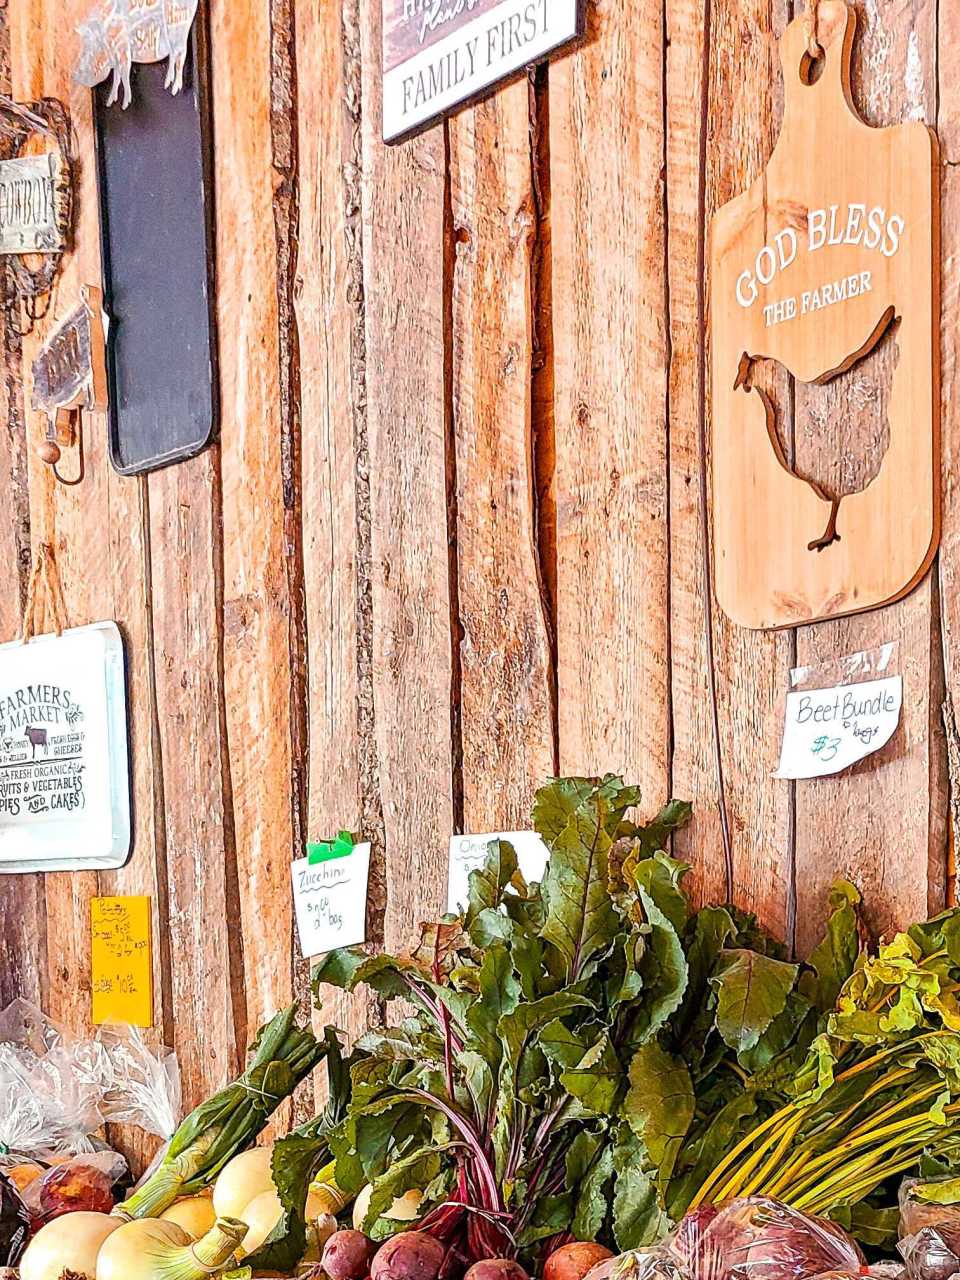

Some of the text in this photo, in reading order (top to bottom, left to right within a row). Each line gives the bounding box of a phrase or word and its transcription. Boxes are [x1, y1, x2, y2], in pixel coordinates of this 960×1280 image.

[402, 37, 479, 115] FAMILY
[486, 0, 549, 67] FIRST
[736, 203, 904, 307] GOD BLESS
[763, 271, 872, 328] THE FARMER
[0, 684, 71, 720] FARMERS
[9, 705, 61, 732] MARKET
[796, 688, 897, 723] Beet Bundle
[10, 764, 67, 780] FRESH ORGANIC
[32, 775, 82, 793] VEGETABLES
